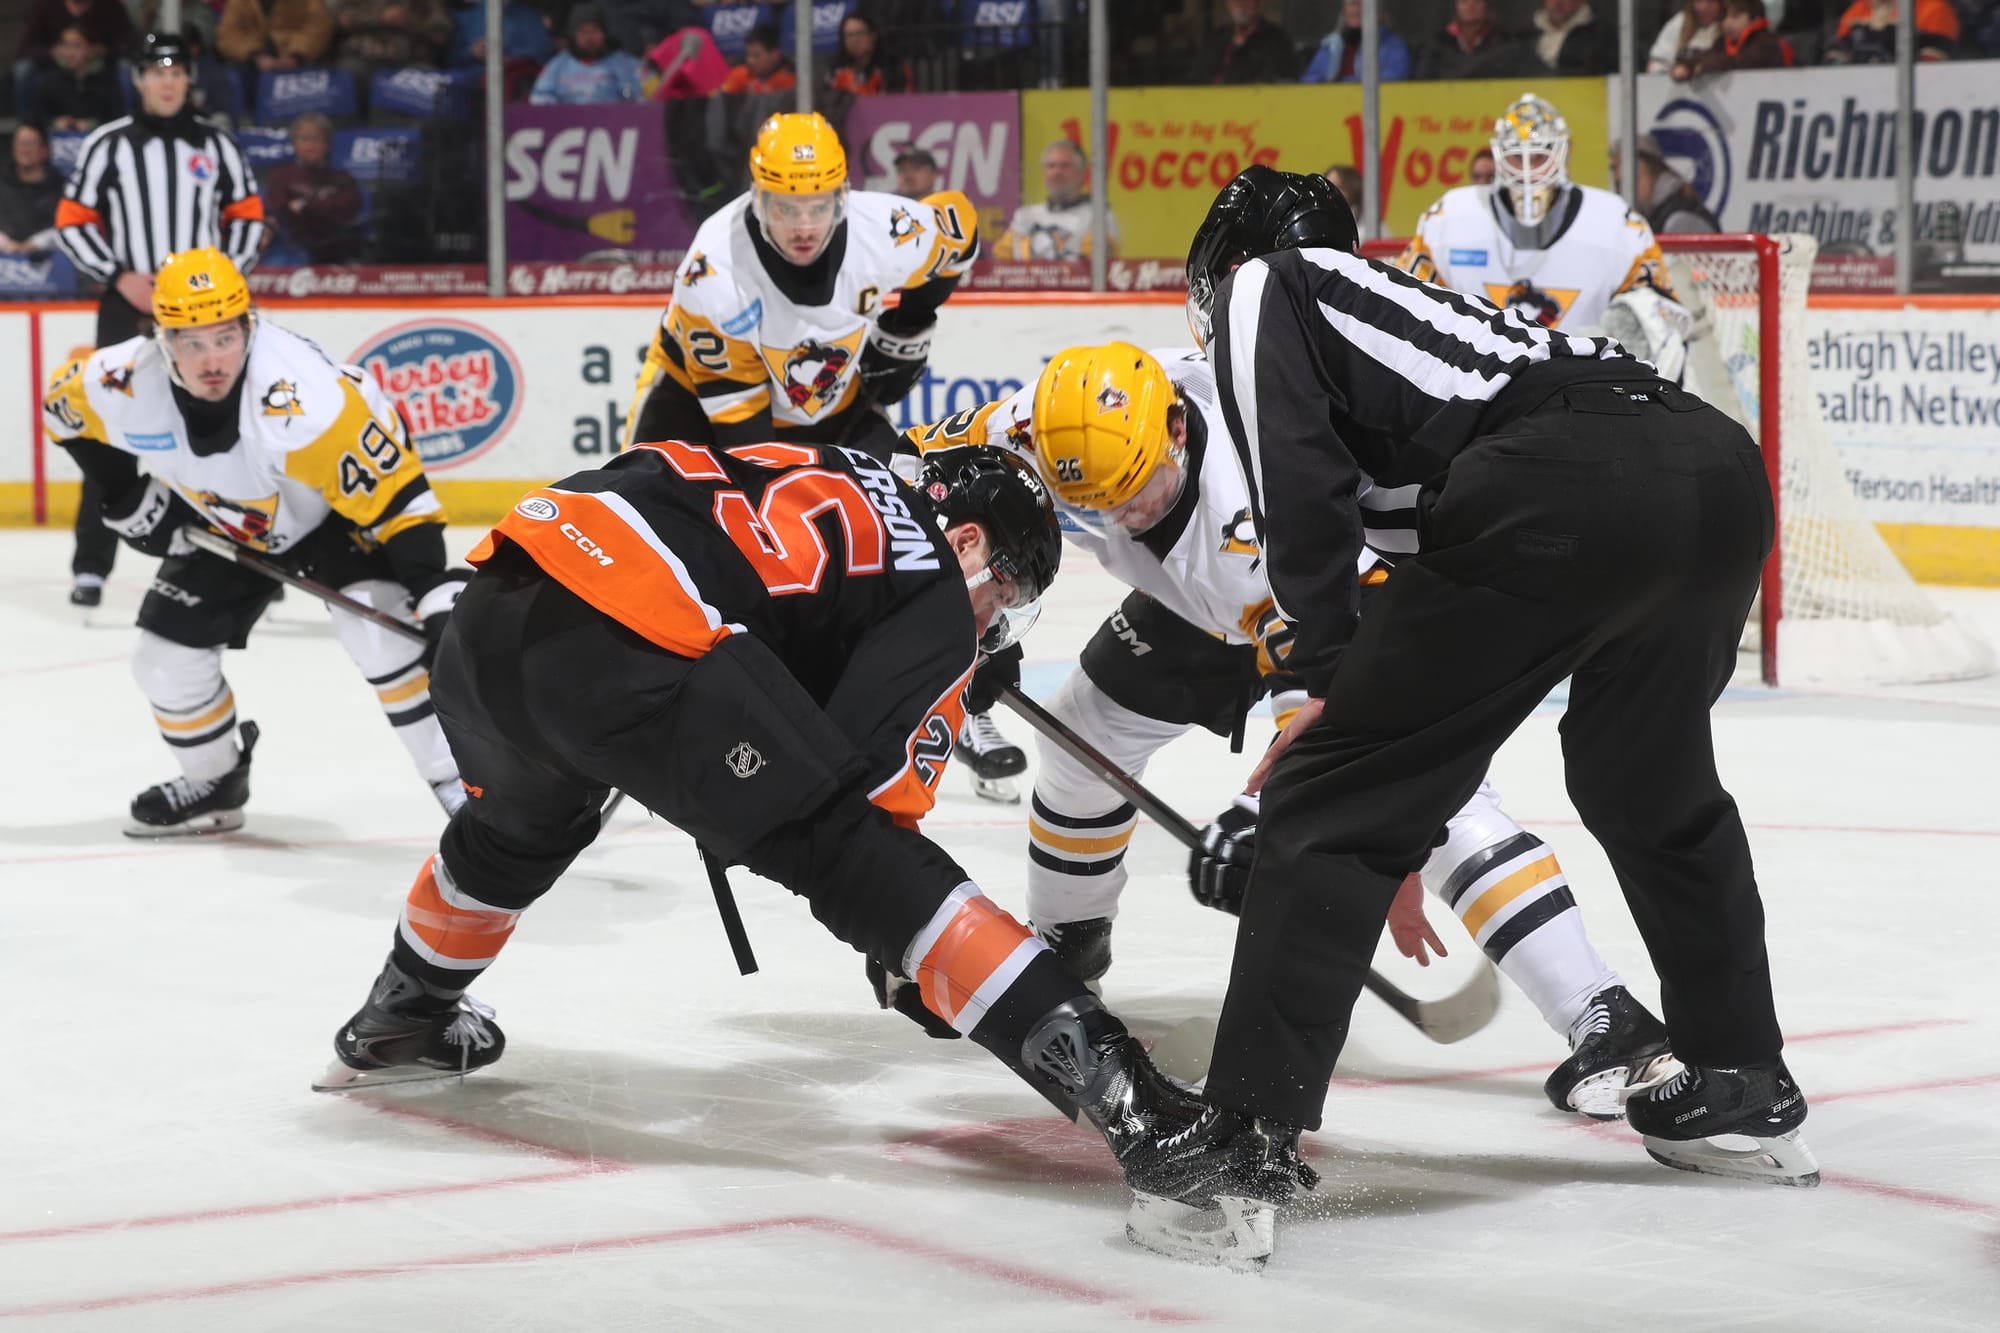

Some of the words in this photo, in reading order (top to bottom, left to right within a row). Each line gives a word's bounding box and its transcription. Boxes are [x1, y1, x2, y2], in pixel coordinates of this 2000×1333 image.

[711, 8, 759, 34] BSI
[505, 126, 639, 201] SEN
[1878, 210, 1898, 246] &
[857, 286, 879, 315] C
[367, 351, 493, 393] Jersey
[582, 346, 611, 384] a
[1807, 330, 1897, 381] ehigh
[340, 420, 401, 495] 49
[1055, 458, 1084, 482] 26
[522, 501, 550, 516] AHL
[560, 522, 615, 567] CCM
[912, 713, 954, 788] 2
[1674, 1105, 1709, 1125] BAUER
